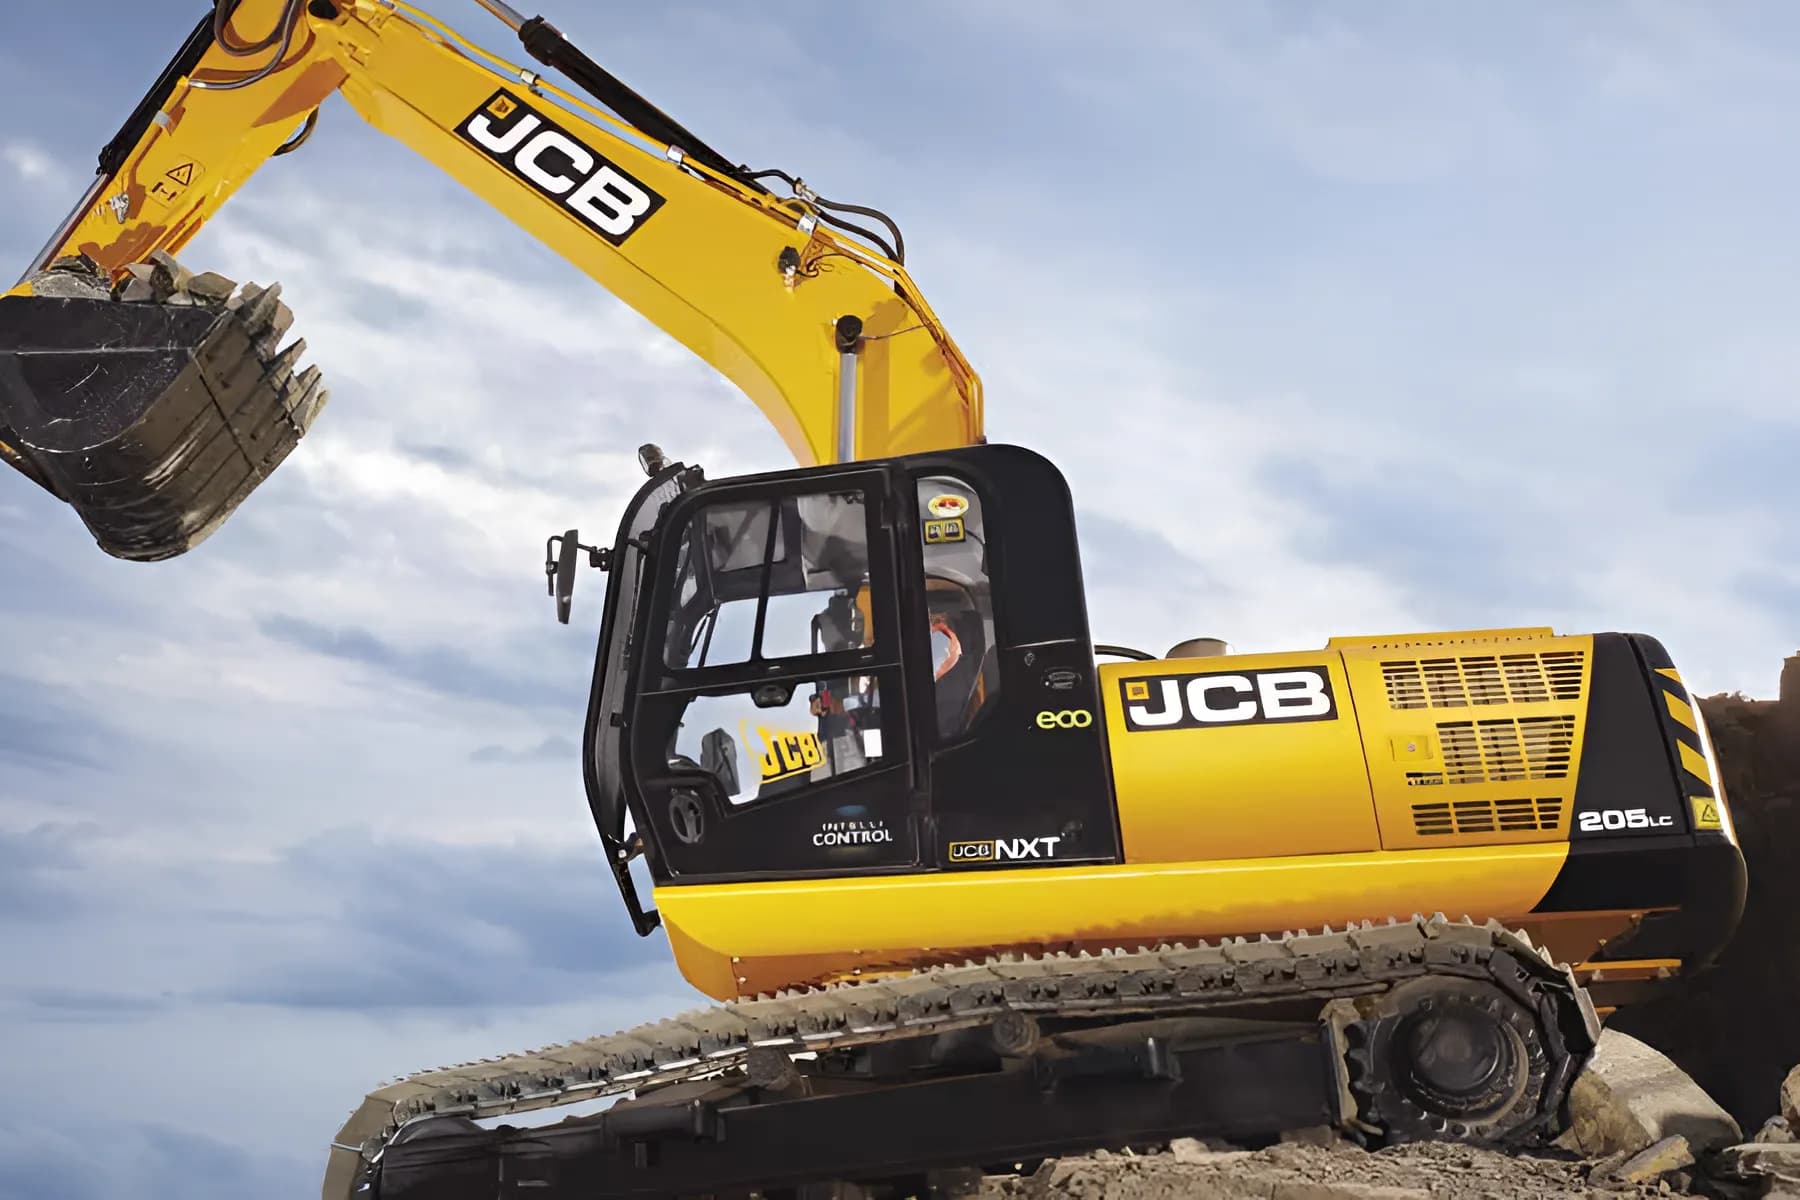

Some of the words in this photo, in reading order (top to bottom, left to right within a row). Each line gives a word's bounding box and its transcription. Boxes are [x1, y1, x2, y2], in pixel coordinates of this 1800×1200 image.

[466, 113, 651, 236] JCB
[1128, 671, 1331, 726] JCB
[1036, 709, 1093, 729] eco
[757, 729, 822, 777] JCB
[812, 829, 894, 847] CONTROL
[995, 837, 1061, 860] NXT
